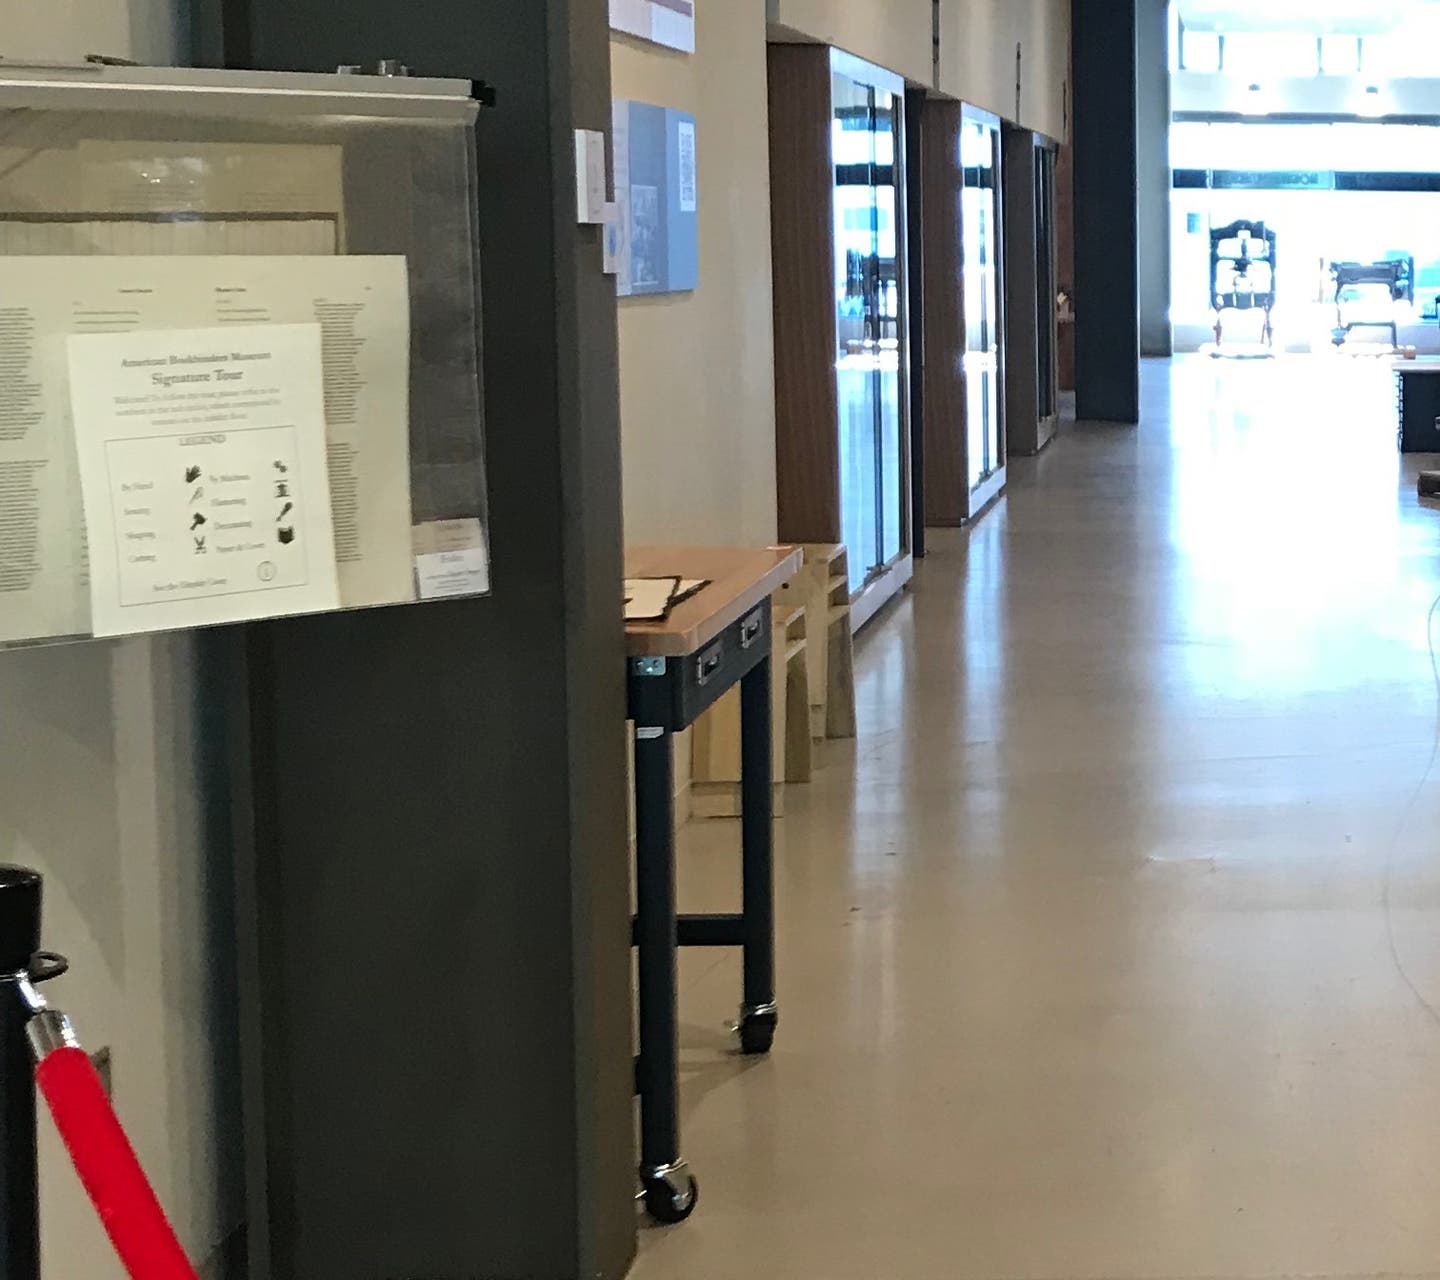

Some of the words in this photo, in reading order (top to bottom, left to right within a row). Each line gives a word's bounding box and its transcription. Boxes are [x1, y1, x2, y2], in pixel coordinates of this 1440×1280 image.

[151, 372, 211, 388] Signature
[213, 369, 244, 381] Tour
[178, 434, 227, 446] LEGEND
